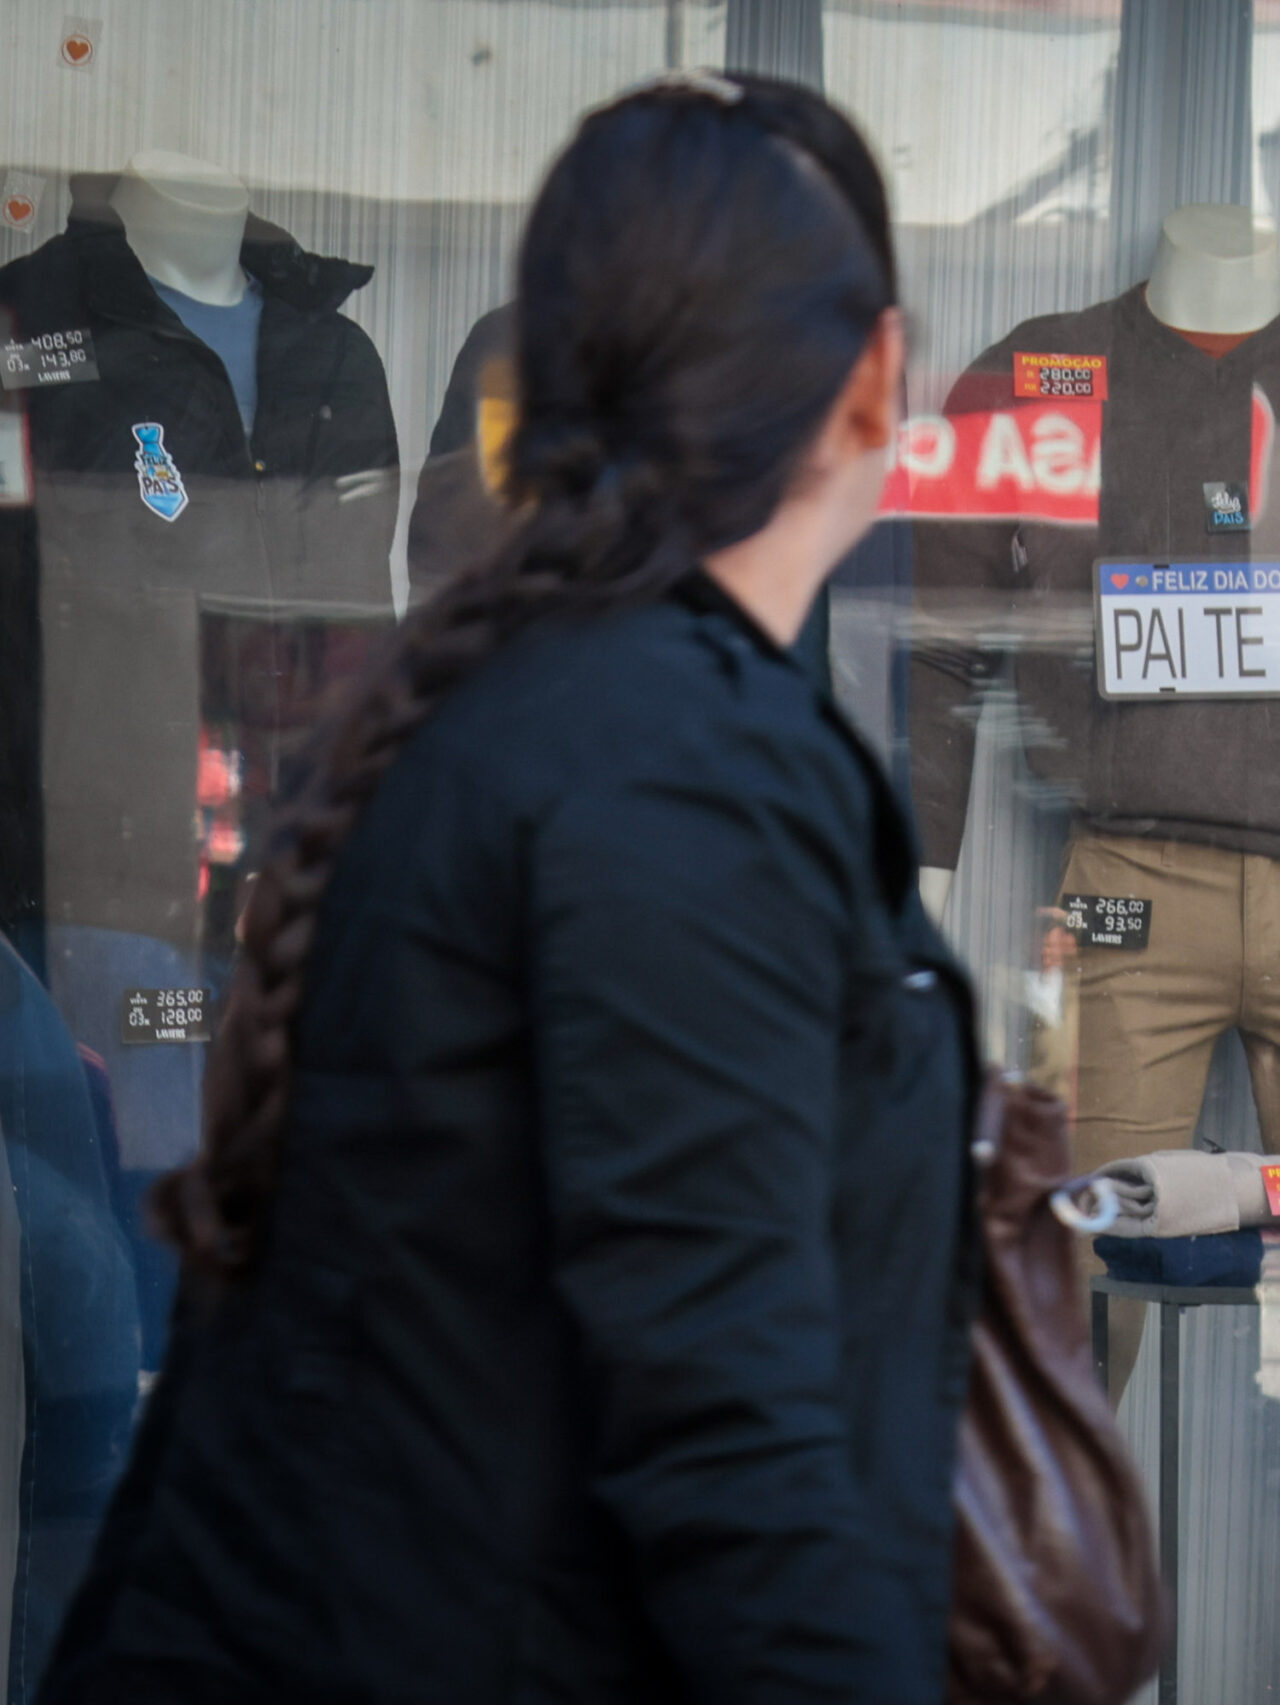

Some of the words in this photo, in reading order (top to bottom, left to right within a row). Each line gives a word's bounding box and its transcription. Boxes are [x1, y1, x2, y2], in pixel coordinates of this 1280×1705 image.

[31, 329, 83, 351] 408,50
[1040, 367, 1092, 382] 280,00
[1040, 381, 1092, 396] 220,00
[1151, 570, 1208, 591] FELIZ
[1213, 570, 1249, 591] DIA
[1113, 607, 1187, 680] PAI
[1203, 606, 1267, 679] TE
[1095, 898, 1144, 916] 266,00
[1105, 915, 1142, 932] 93,50
[156, 989, 203, 1007] 365,00
[161, 1007, 203, 1026] 128,00
